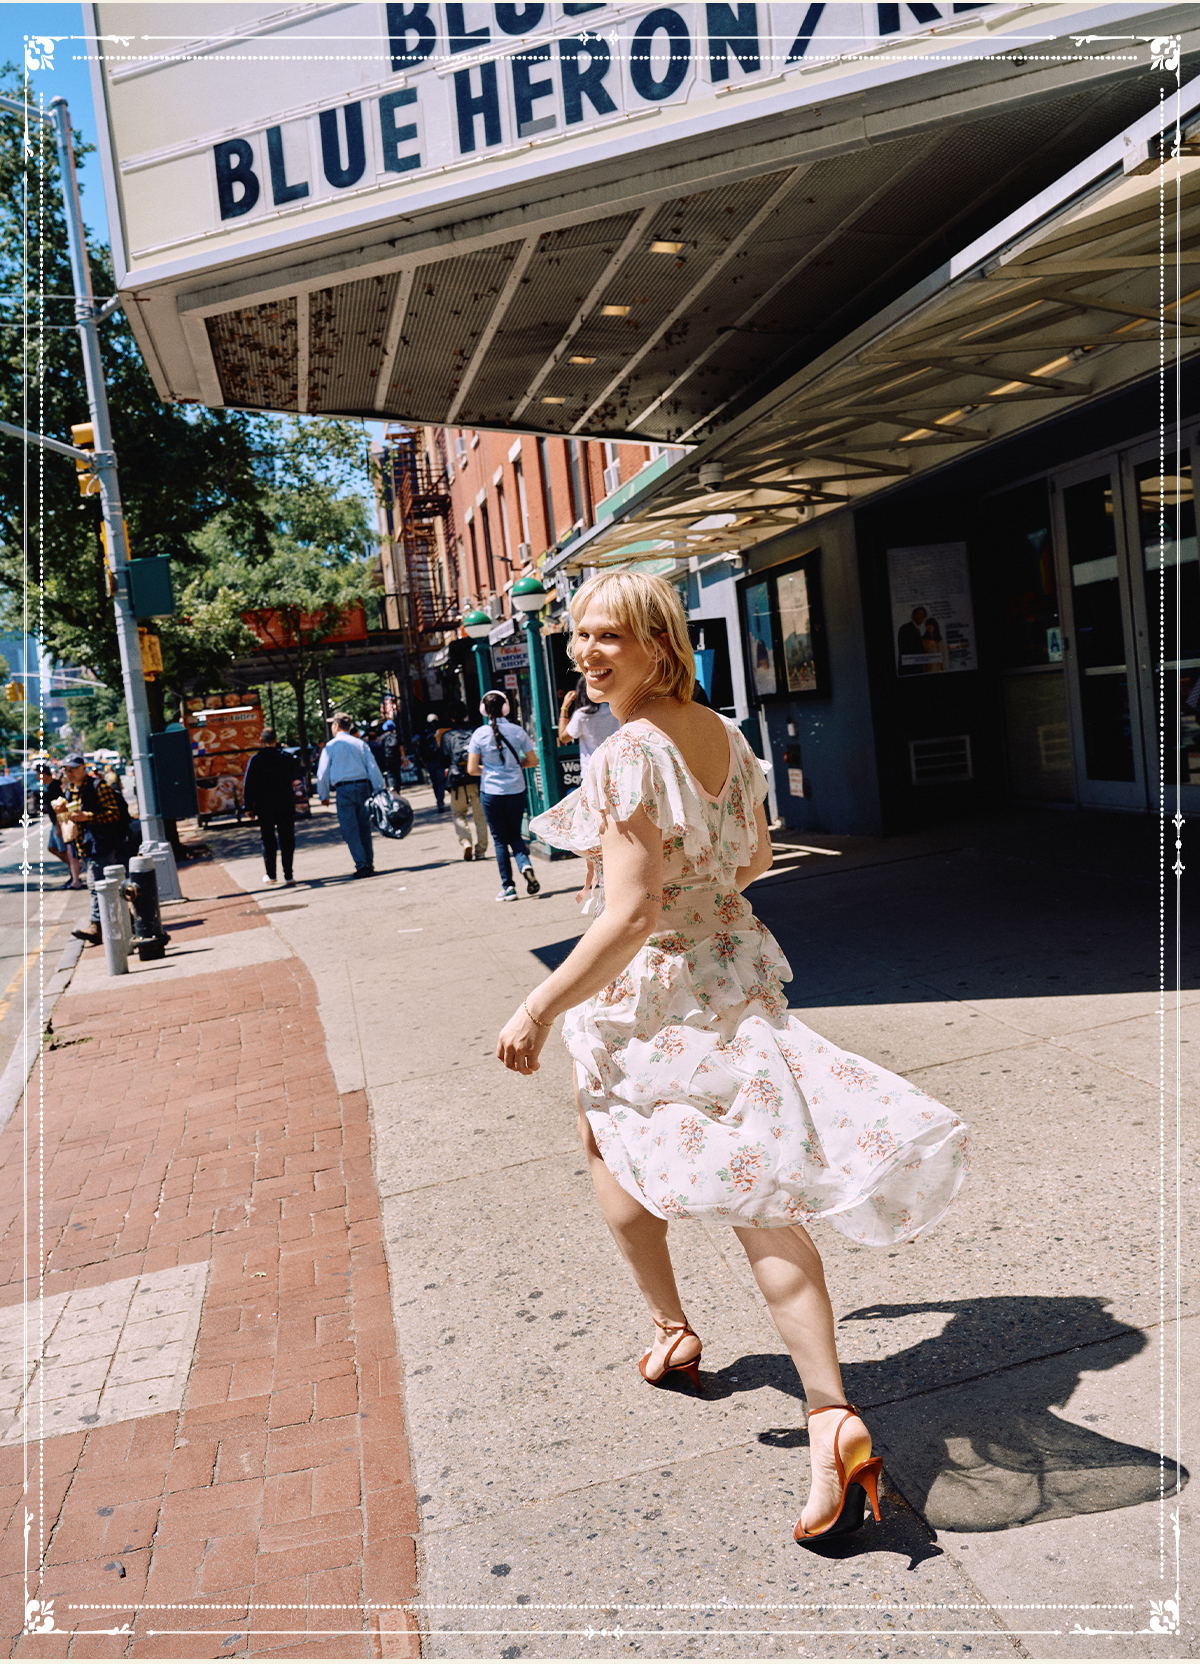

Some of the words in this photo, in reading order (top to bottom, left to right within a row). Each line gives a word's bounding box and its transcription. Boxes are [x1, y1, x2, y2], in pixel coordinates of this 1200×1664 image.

[214, 87, 422, 221] BLUE
[454, 3, 762, 156] HERON
[1050, 632, 1060, 653] A
[496, 652, 529, 663] SMOKE
[501, 659, 526, 668] SHOP
[562, 761, 581, 773] We
